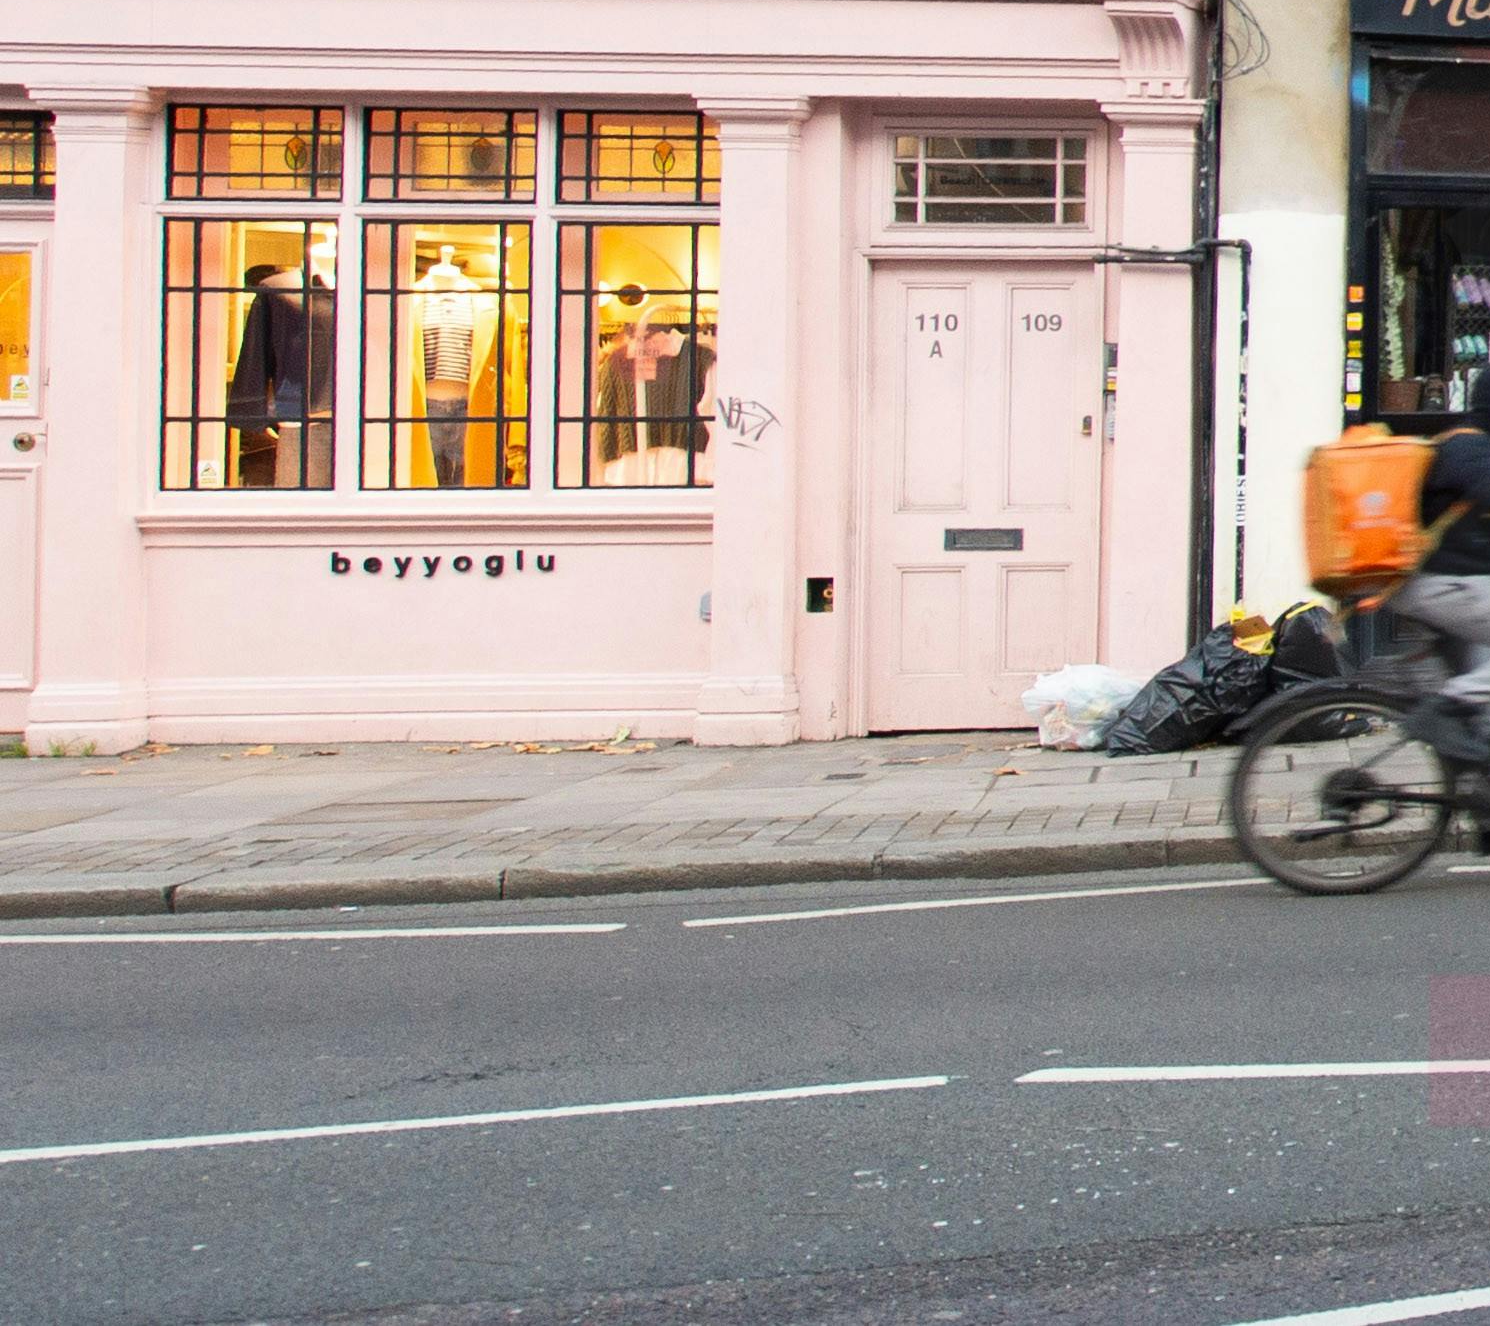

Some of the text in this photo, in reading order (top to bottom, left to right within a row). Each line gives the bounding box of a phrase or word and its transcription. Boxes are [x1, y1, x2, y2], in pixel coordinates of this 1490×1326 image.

[915, 313, 959, 332] 110
[1021, 313, 1063, 332] 109
[929, 340, 943, 358] A
[331, 550, 555, 578] beyyoglu
